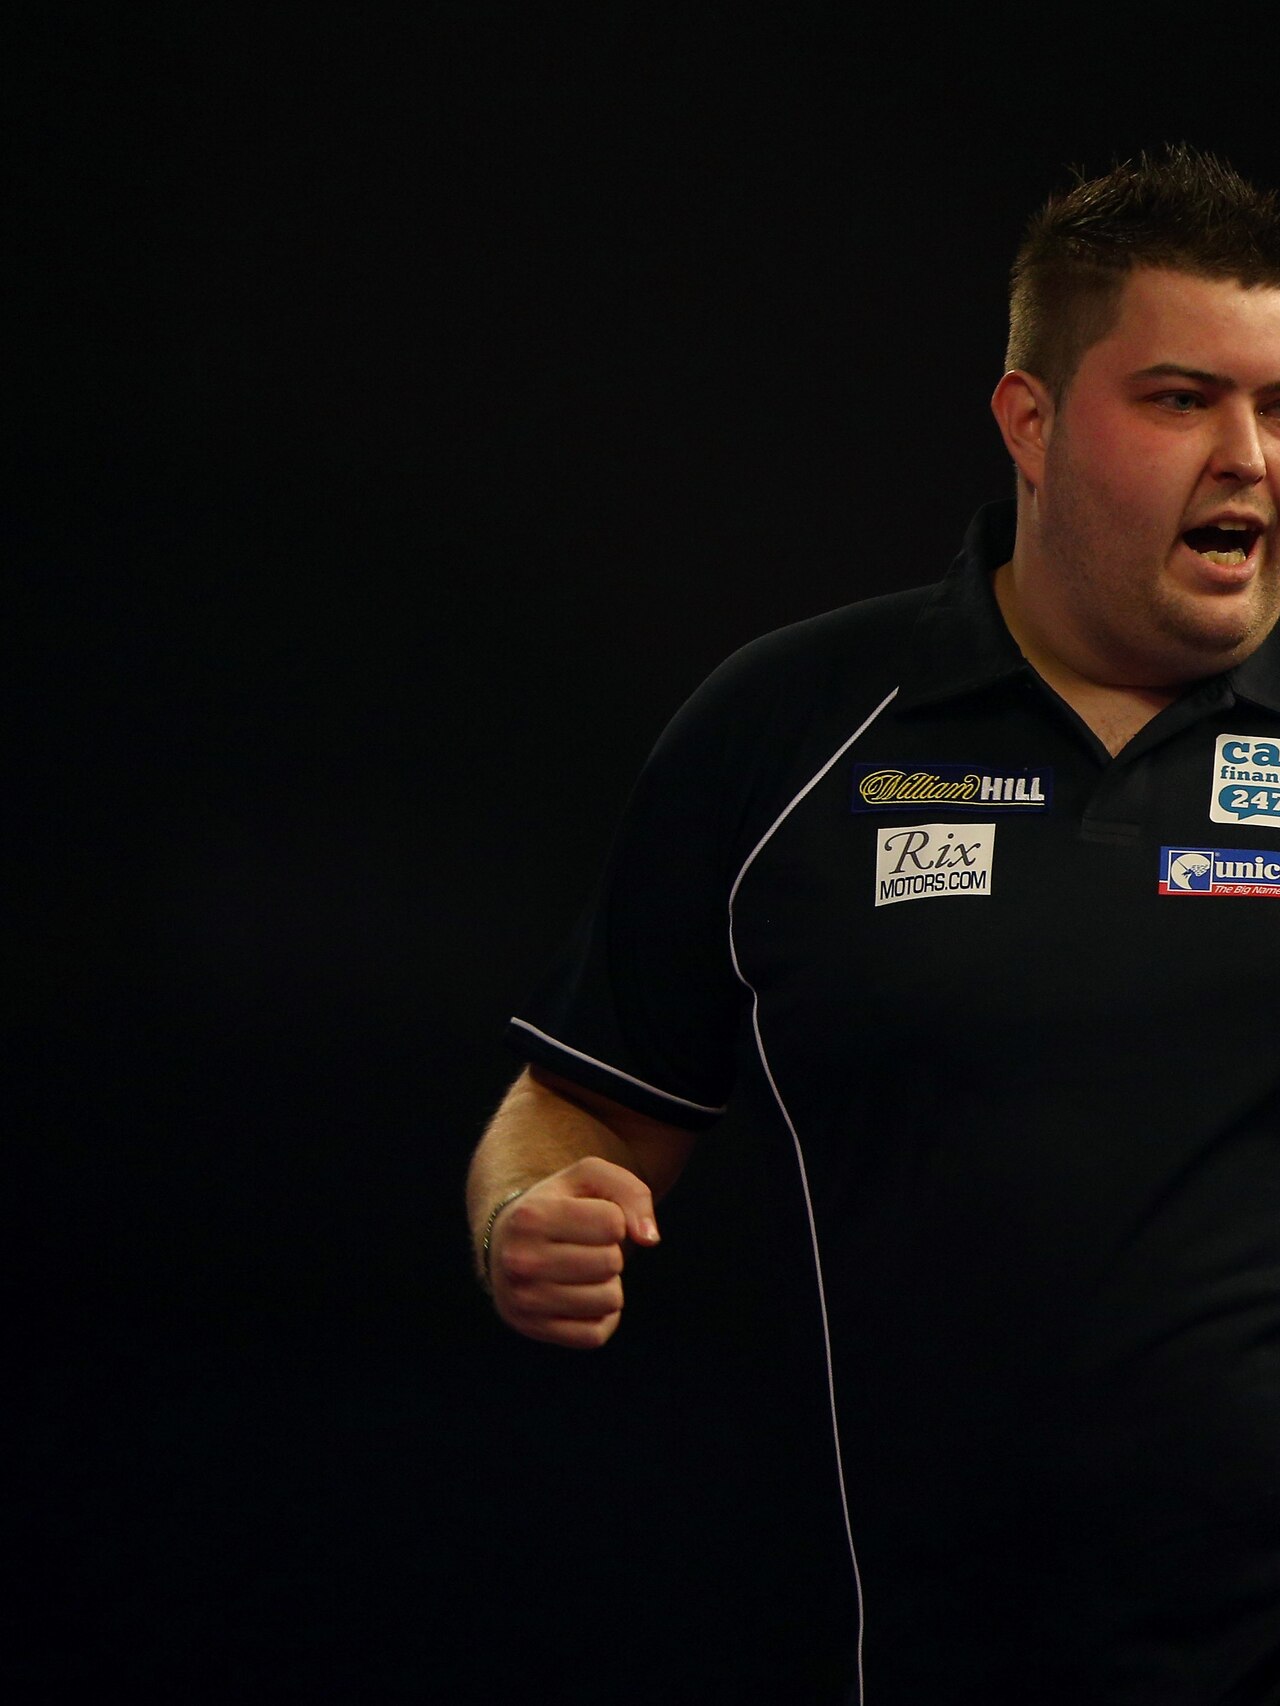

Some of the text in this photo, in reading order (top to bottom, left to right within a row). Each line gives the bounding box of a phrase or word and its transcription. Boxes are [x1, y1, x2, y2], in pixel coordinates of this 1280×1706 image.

[859, 769, 1045, 802] William HILL
[884, 830, 981, 875] Rix
[880, 870, 987, 900] MOTORS.COM
[1214, 885, 1234, 894] The
[1233, 886, 1253, 896] Big
